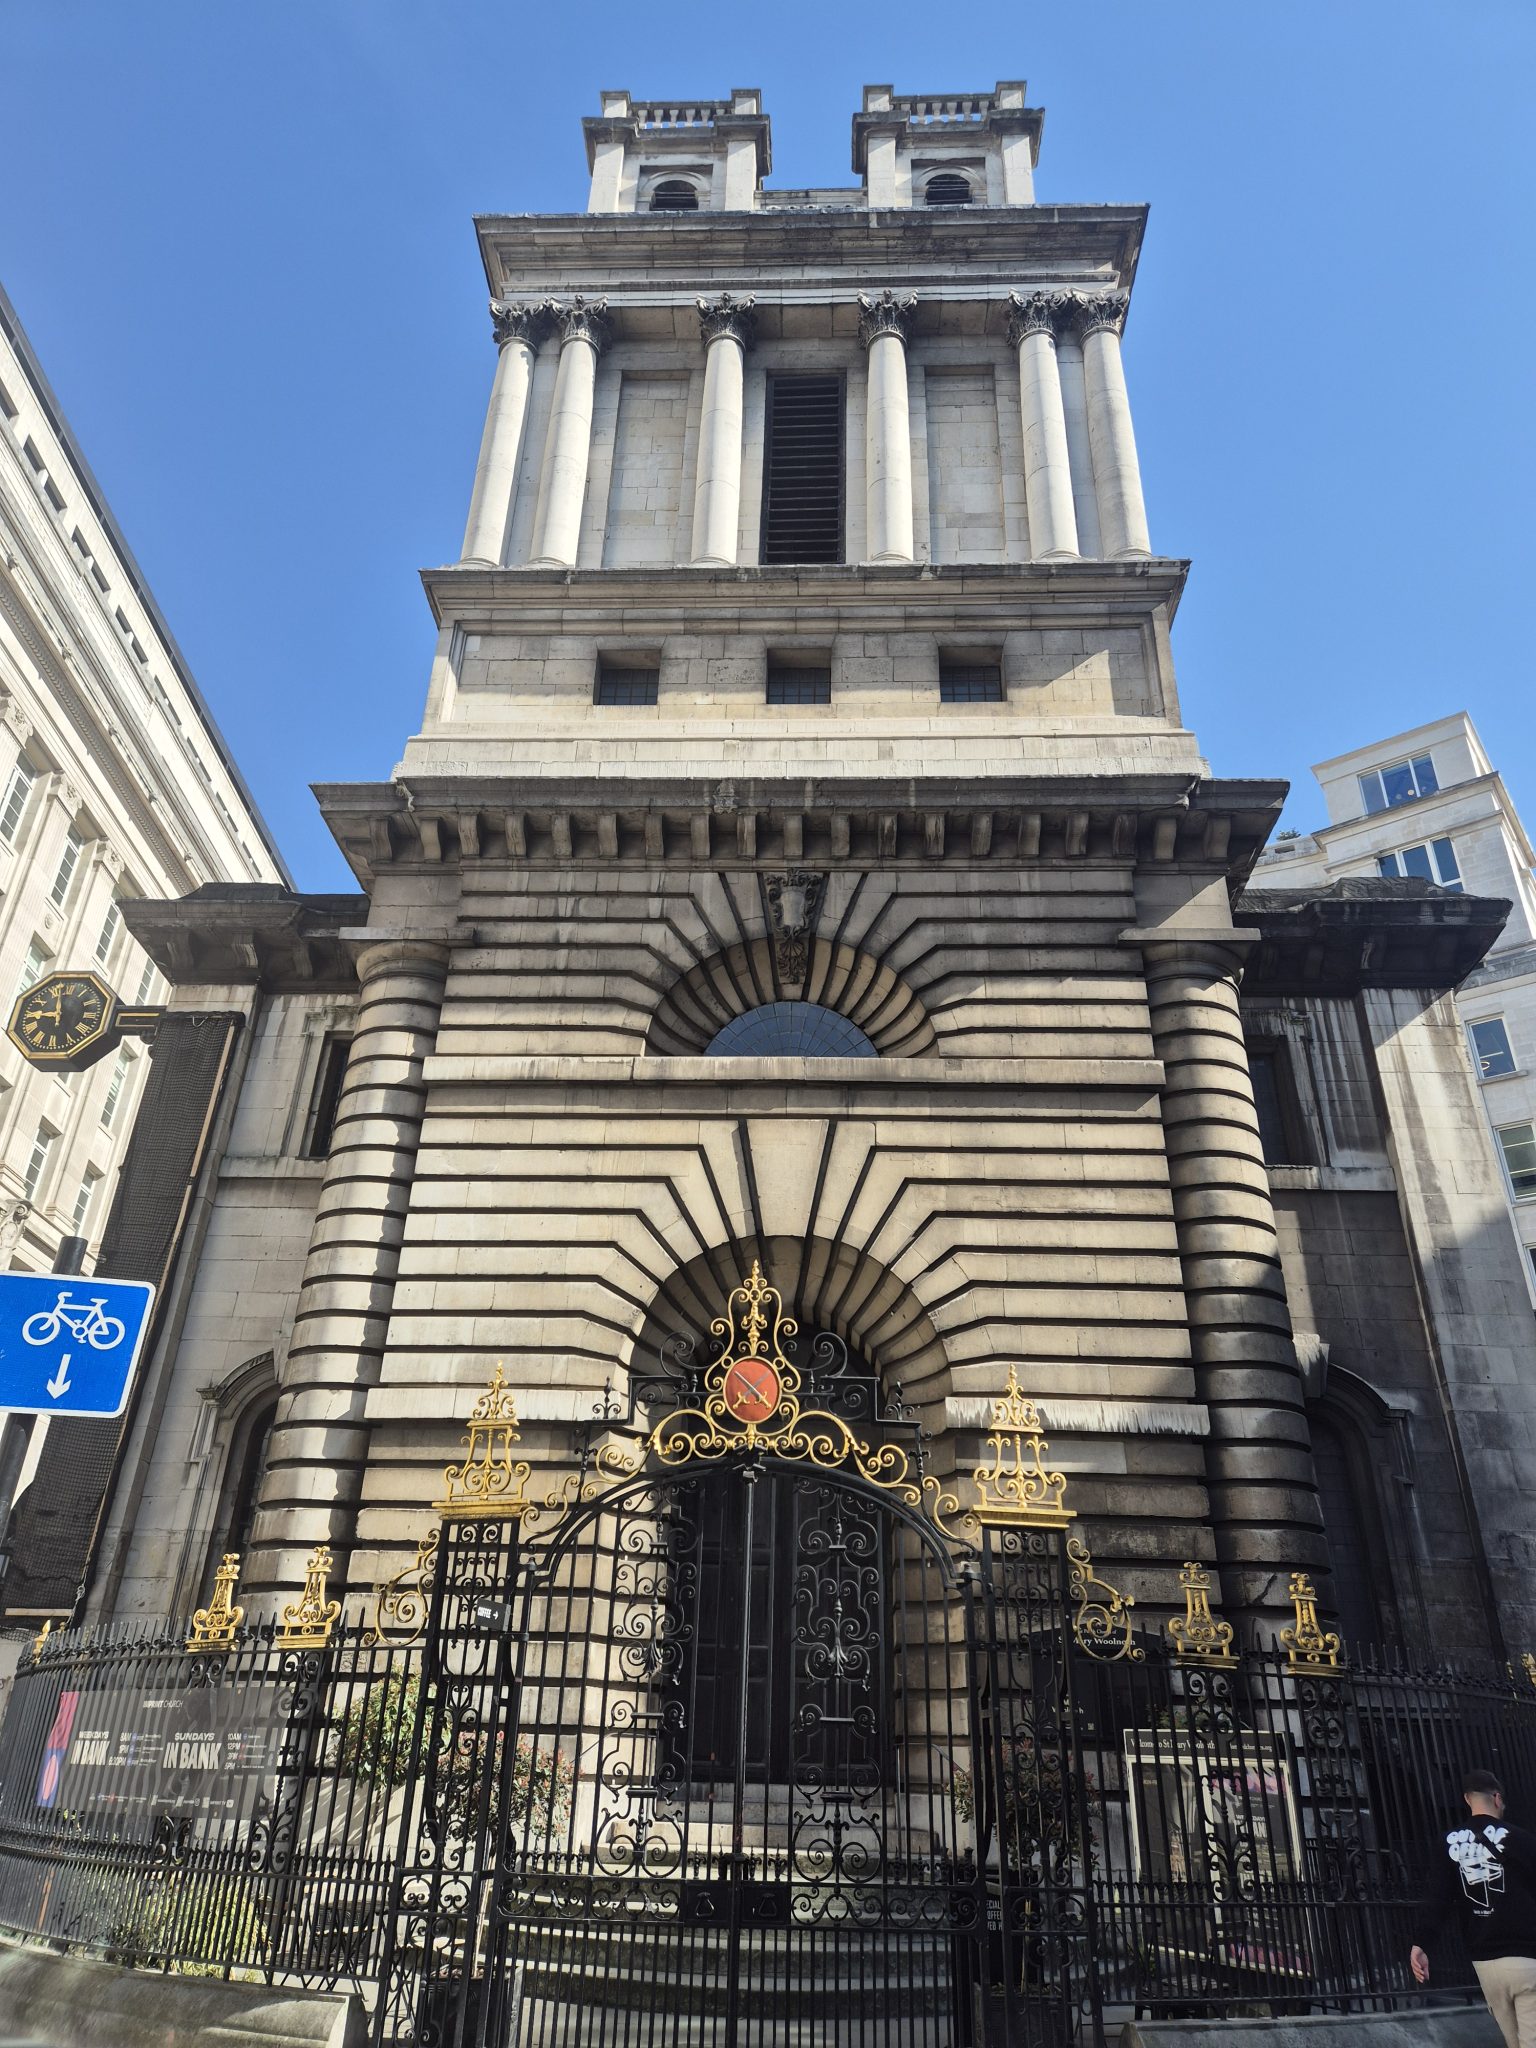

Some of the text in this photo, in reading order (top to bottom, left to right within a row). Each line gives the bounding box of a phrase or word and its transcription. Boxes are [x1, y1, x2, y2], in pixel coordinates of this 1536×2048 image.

[1073, 1636, 1092, 1647] Mry
[1093, 1637, 1136, 1646] Woolnoh
[164, 1699, 184, 1708] CHURCH
[79, 1731, 109, 1739] WEEKDAYS
[174, 1732, 216, 1741] SUNDAYS
[227, 1733, 242, 1741] 10AM
[70, 1740, 110, 1766] IN BANK
[163, 1742, 222, 1770] IN BANK
